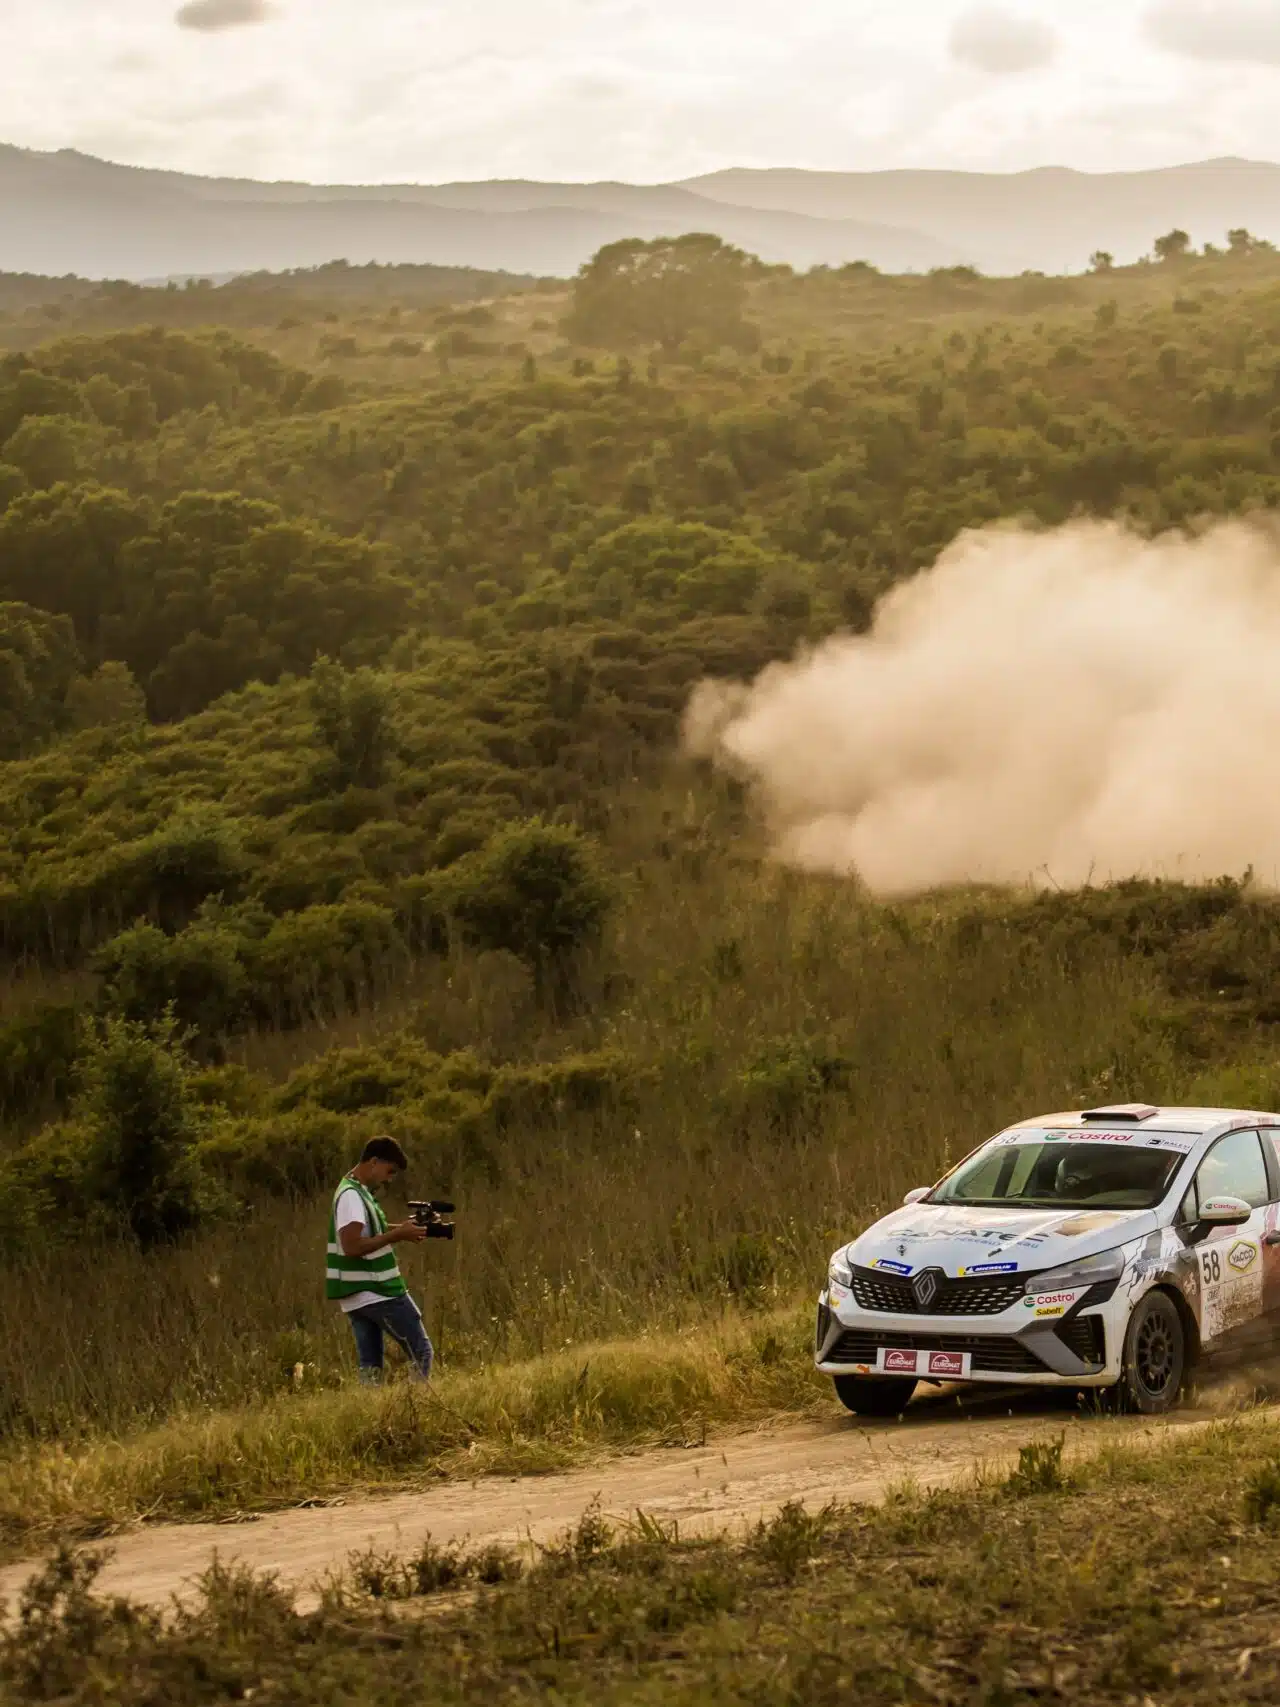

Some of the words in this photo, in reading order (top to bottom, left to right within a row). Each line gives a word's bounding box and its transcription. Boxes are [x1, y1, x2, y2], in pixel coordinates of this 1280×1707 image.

[1067, 1131, 1133, 1141] Castrol
[1232, 1249, 1253, 1263] YACCO
[975, 1264, 1011, 1272] MICHELIN
[1201, 1250, 1220, 1284] 58
[1037, 1292, 1075, 1304] Castrol
[889, 1358, 915, 1366] EUROMAT
